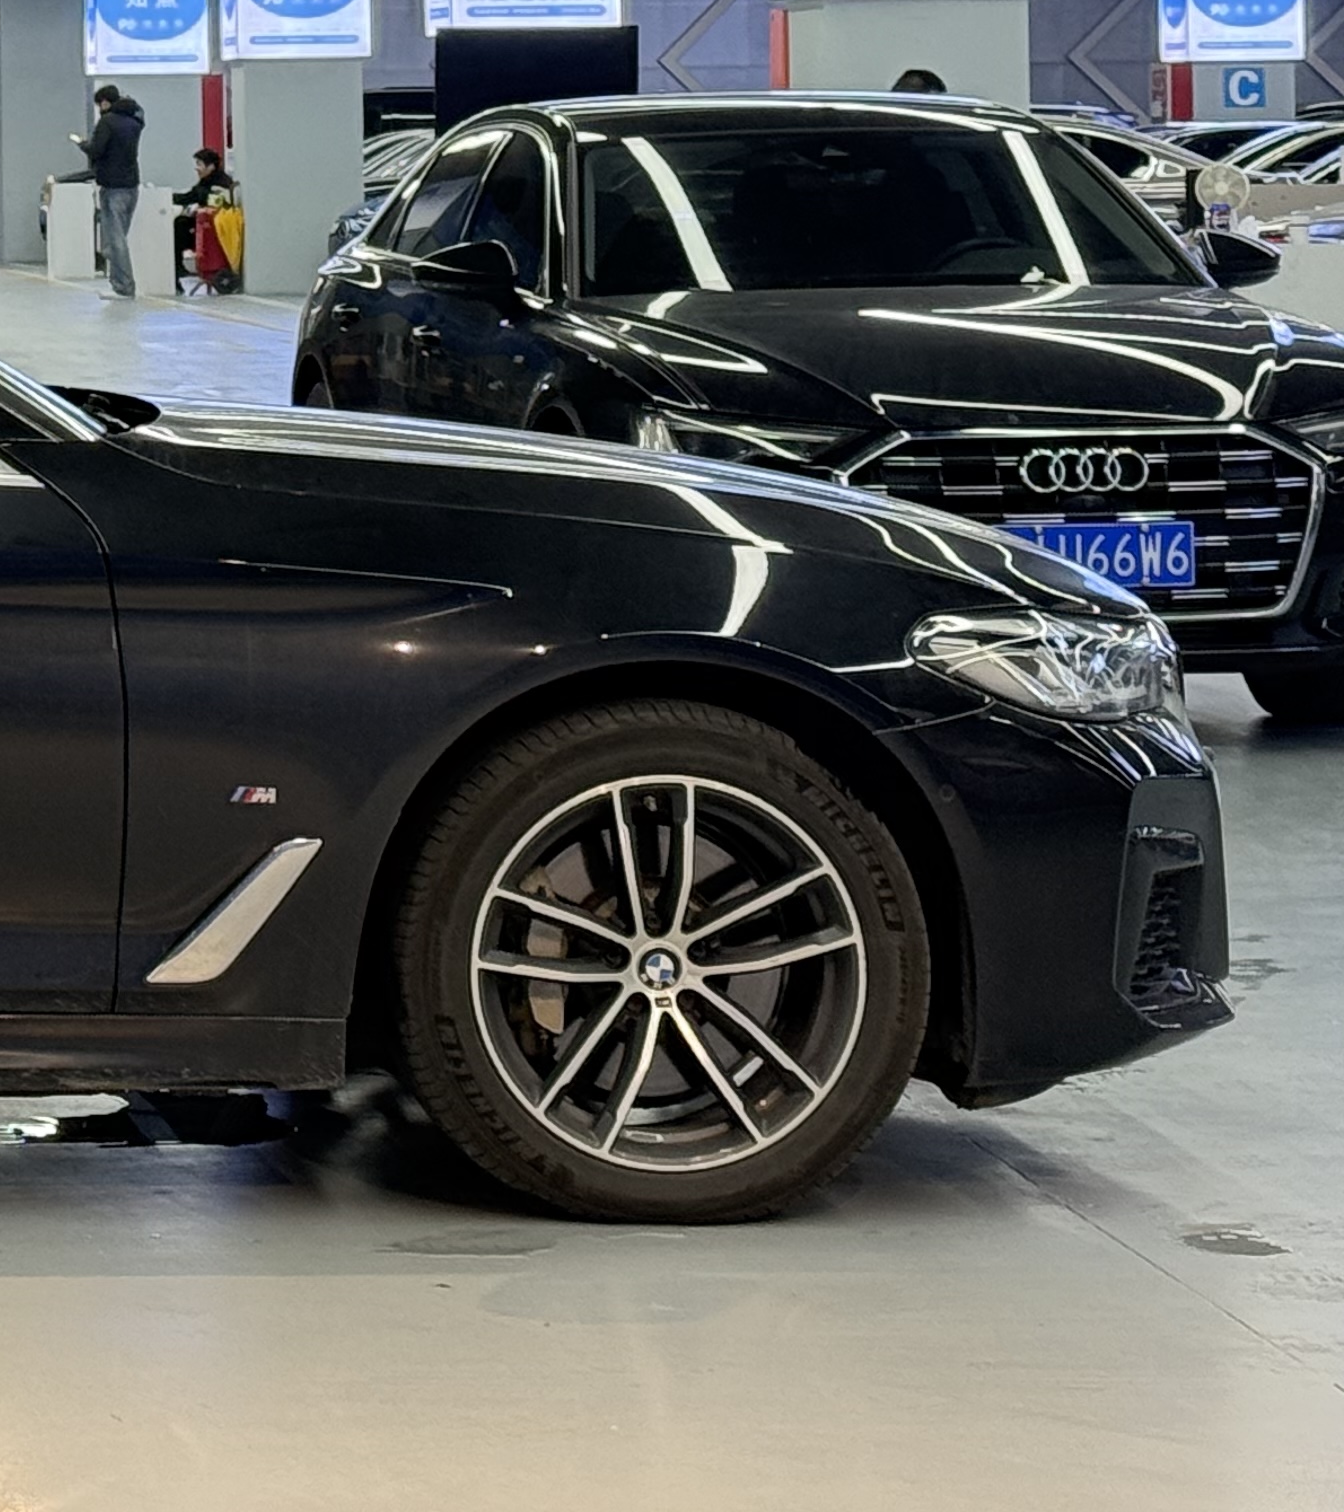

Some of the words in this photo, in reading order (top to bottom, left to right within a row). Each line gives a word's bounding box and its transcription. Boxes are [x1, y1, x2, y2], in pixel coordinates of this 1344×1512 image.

[1228, 69, 1261, 107] C
[1036, 533, 1191, 580] U66W6
[801, 783, 904, 928] MICHELIN
